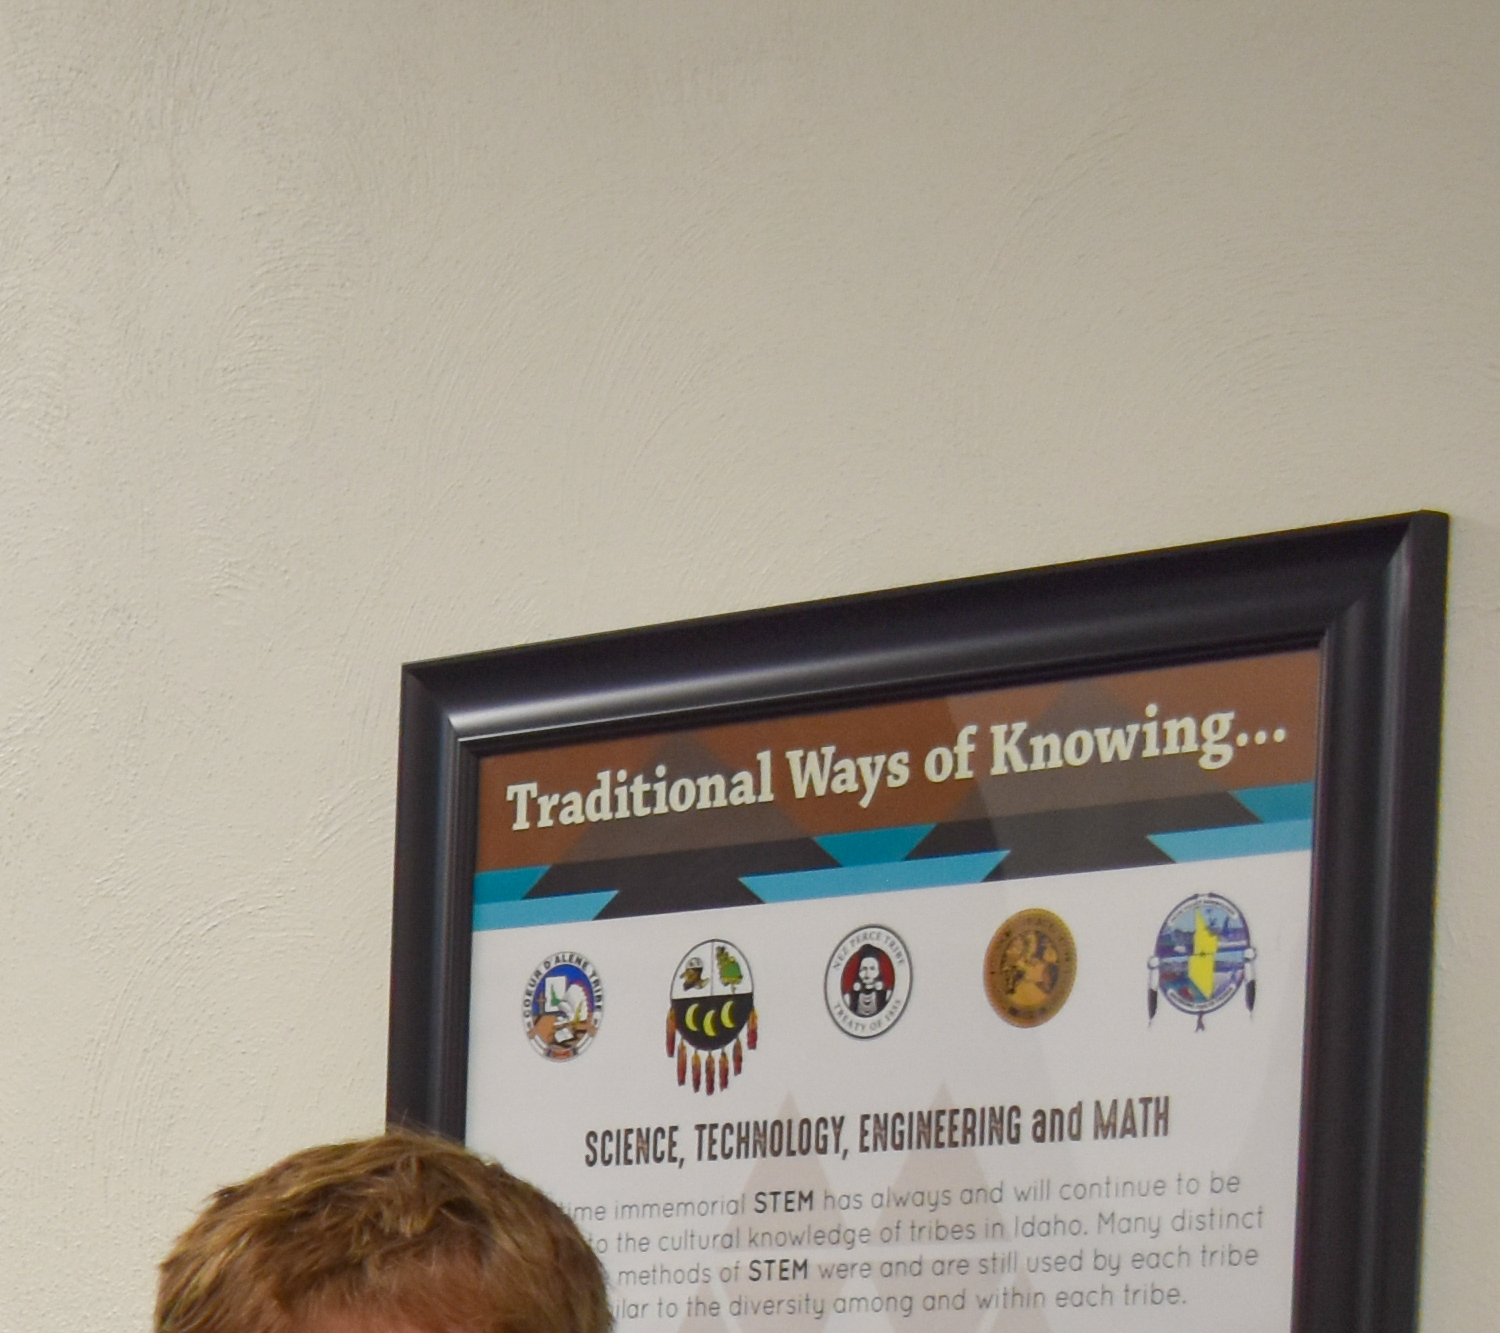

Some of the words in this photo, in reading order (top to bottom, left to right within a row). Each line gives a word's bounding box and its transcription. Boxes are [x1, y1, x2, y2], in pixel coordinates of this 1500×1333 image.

[507, 751, 773, 830] Traditional
[787, 743, 910, 806] Ways
[924, 724, 976, 782] of
[990, 704, 1287, 775] Knowing...
[585, 1126, 686, 1169] SCIENCE,
[695, 1115, 849, 1162] TECHNOLOGY,
[858, 1104, 1021, 1153] ENGINEERING
[1031, 1101, 1082, 1143] and
[1093, 1096, 1170, 1140] MATH
[614, 1194, 746, 1220] immemorial
[753, 1191, 814, 1213] STEM
[823, 1188, 862, 1211] has
[871, 1185, 951, 1212] always
[959, 1181, 1003, 1204] and
[1013, 1177, 1051, 1202] will
[1059, 1175, 1167, 1200] continue
[1176, 1172, 1200, 1194] to
[1210, 1170, 1241, 1193] be
[617, 1231, 650, 1254] the
[658, 1227, 740, 1251] cultural
[748, 1222, 871, 1250] knowledge
[880, 1219, 904, 1244] of
[910, 1218, 976, 1242] tribes
[985, 1217, 1004, 1239] in
[1014, 1214, 1088, 1238] Idaho.
[1097, 1210, 1161, 1238] Many
[1171, 1205, 1265, 1233] distinct
[618, 1262, 711, 1286] methods
[720, 1260, 740, 1283] of
[748, 1259, 808, 1282] STEM
[818, 1260, 872, 1280] were
[880, 1255, 923, 1278] and
[932, 1257, 970, 1277] are
[978, 1250, 1018, 1275] still
[1026, 1249, 1083, 1273] used
[1093, 1248, 1122, 1277] by
[1131, 1248, 1191, 1271] each
[1200, 1246, 1259, 1268] tribe
[657, 1297, 678, 1318] to
[687, 1295, 720, 1318] the
[729, 1293, 824, 1320] diversity
[833, 1297, 913, 1317] among
[923, 1289, 966, 1311] and
[975, 1286, 1046, 1310] within
[1055, 1284, 1114, 1308] each
[1124, 1283, 1187, 1305] tribe.
